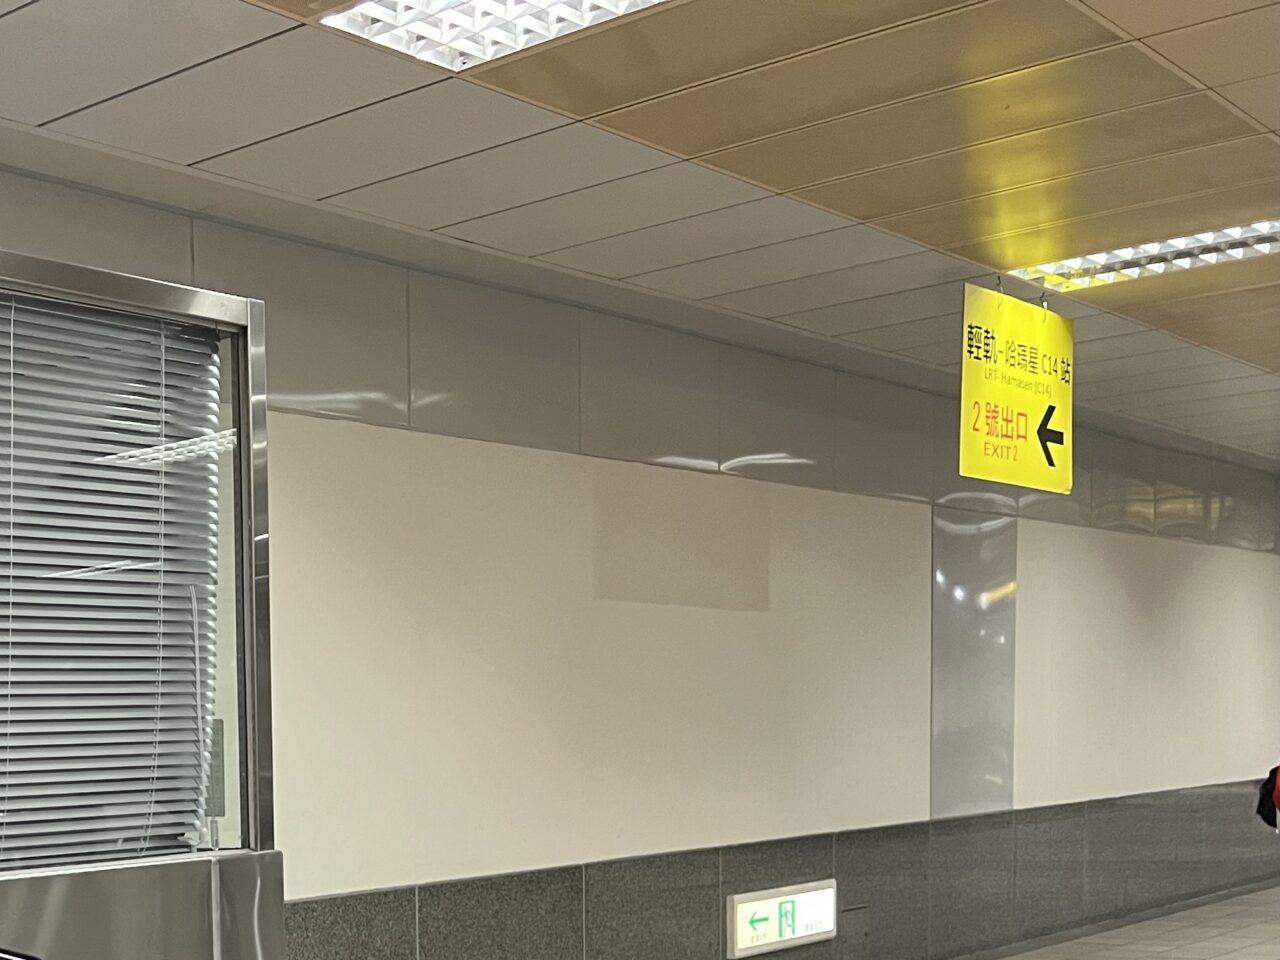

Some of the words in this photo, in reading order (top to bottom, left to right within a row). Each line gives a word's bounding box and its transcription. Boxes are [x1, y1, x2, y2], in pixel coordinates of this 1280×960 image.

[1041, 354, 1058, 376] C14
[1060, 357, 1071, 385] 站
[972, 401, 981, 432] 2
[985, 402, 1028, 443] 號出口
[983, 442, 1011, 460] EXIT
[1013, 445, 1018, 461] 2
